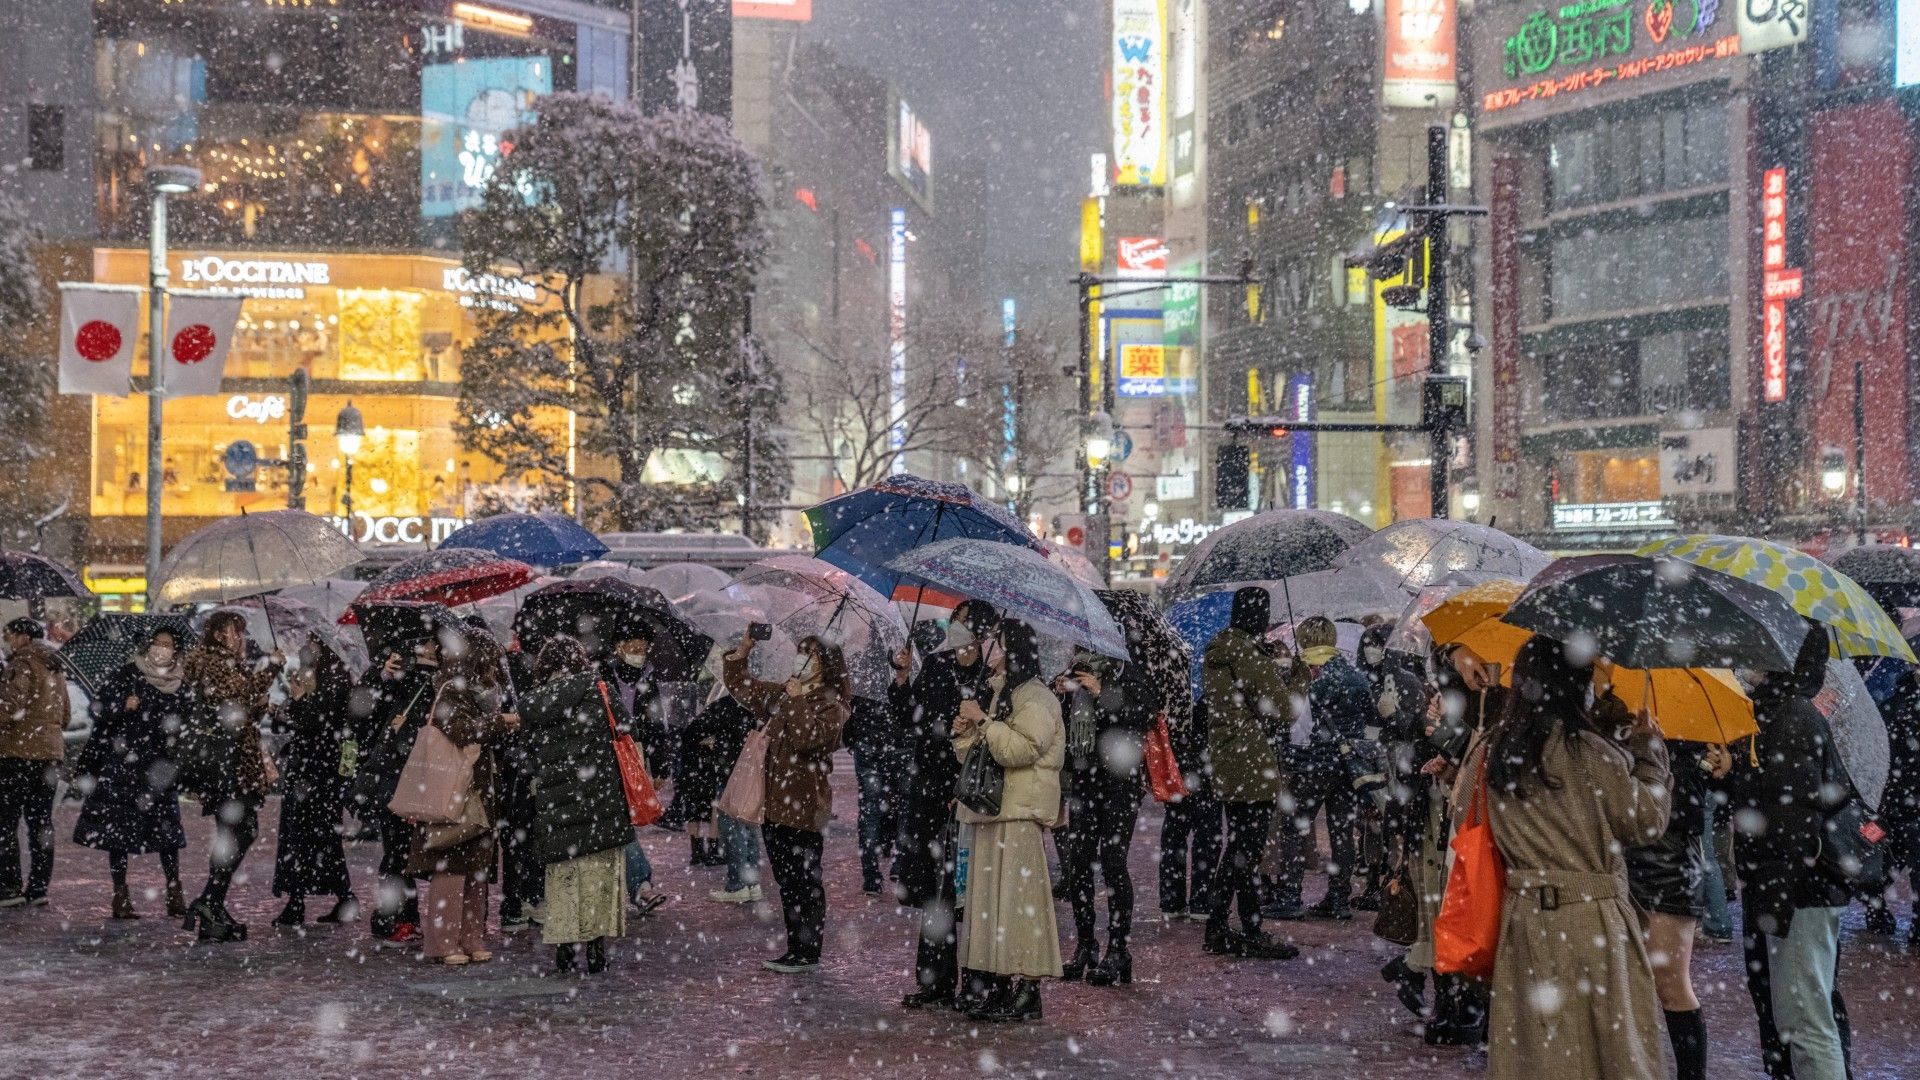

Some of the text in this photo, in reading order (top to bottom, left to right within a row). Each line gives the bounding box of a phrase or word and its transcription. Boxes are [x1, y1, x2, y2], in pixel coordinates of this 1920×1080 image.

[1560, 7, 1633, 65] 西村
[182, 256, 330, 284] L'OCCITANE
[1128, 345, 1161, 376] 薬
[226, 394, 285, 425] Café
